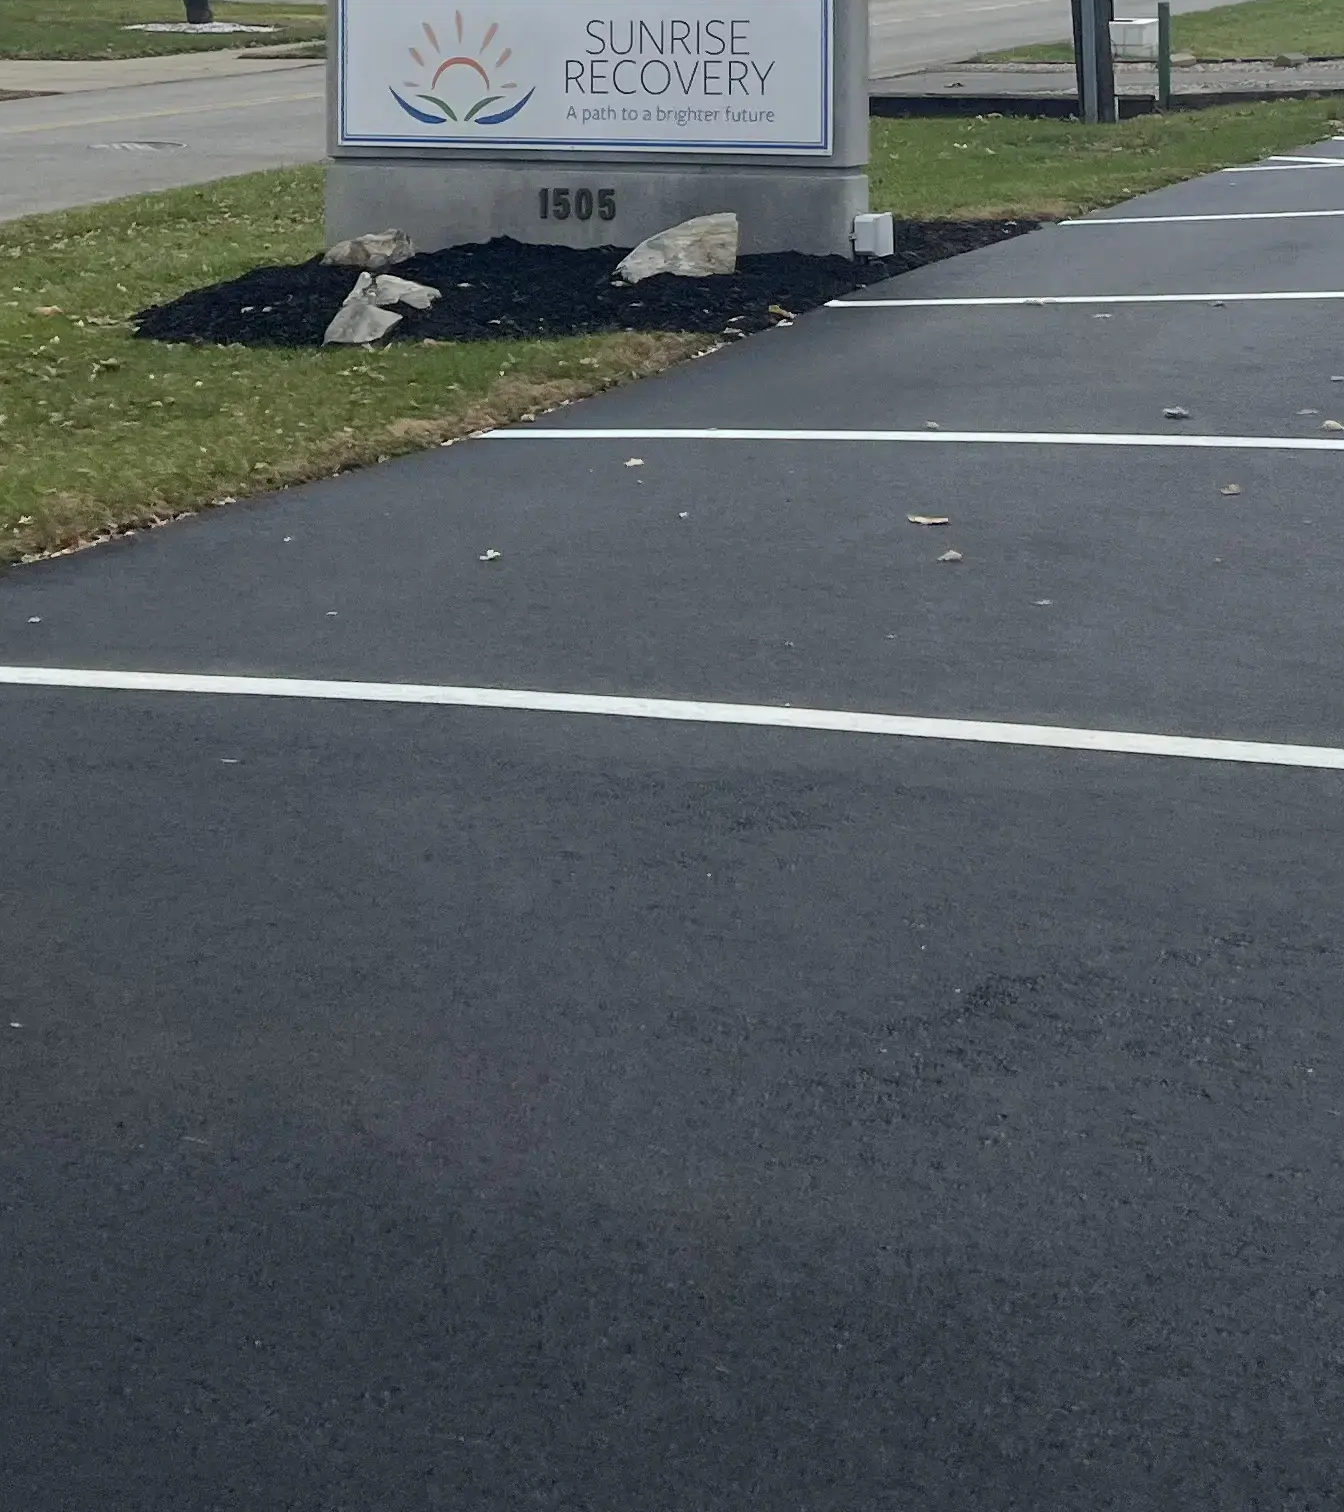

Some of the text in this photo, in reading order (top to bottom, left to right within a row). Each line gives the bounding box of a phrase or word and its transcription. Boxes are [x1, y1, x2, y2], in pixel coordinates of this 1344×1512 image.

[585, 19, 750, 55] SUNRISE
[565, 59, 775, 95] RECOVERY
[566, 105, 775, 126] A path to a brighter future
[538, 187, 616, 221] 1505
